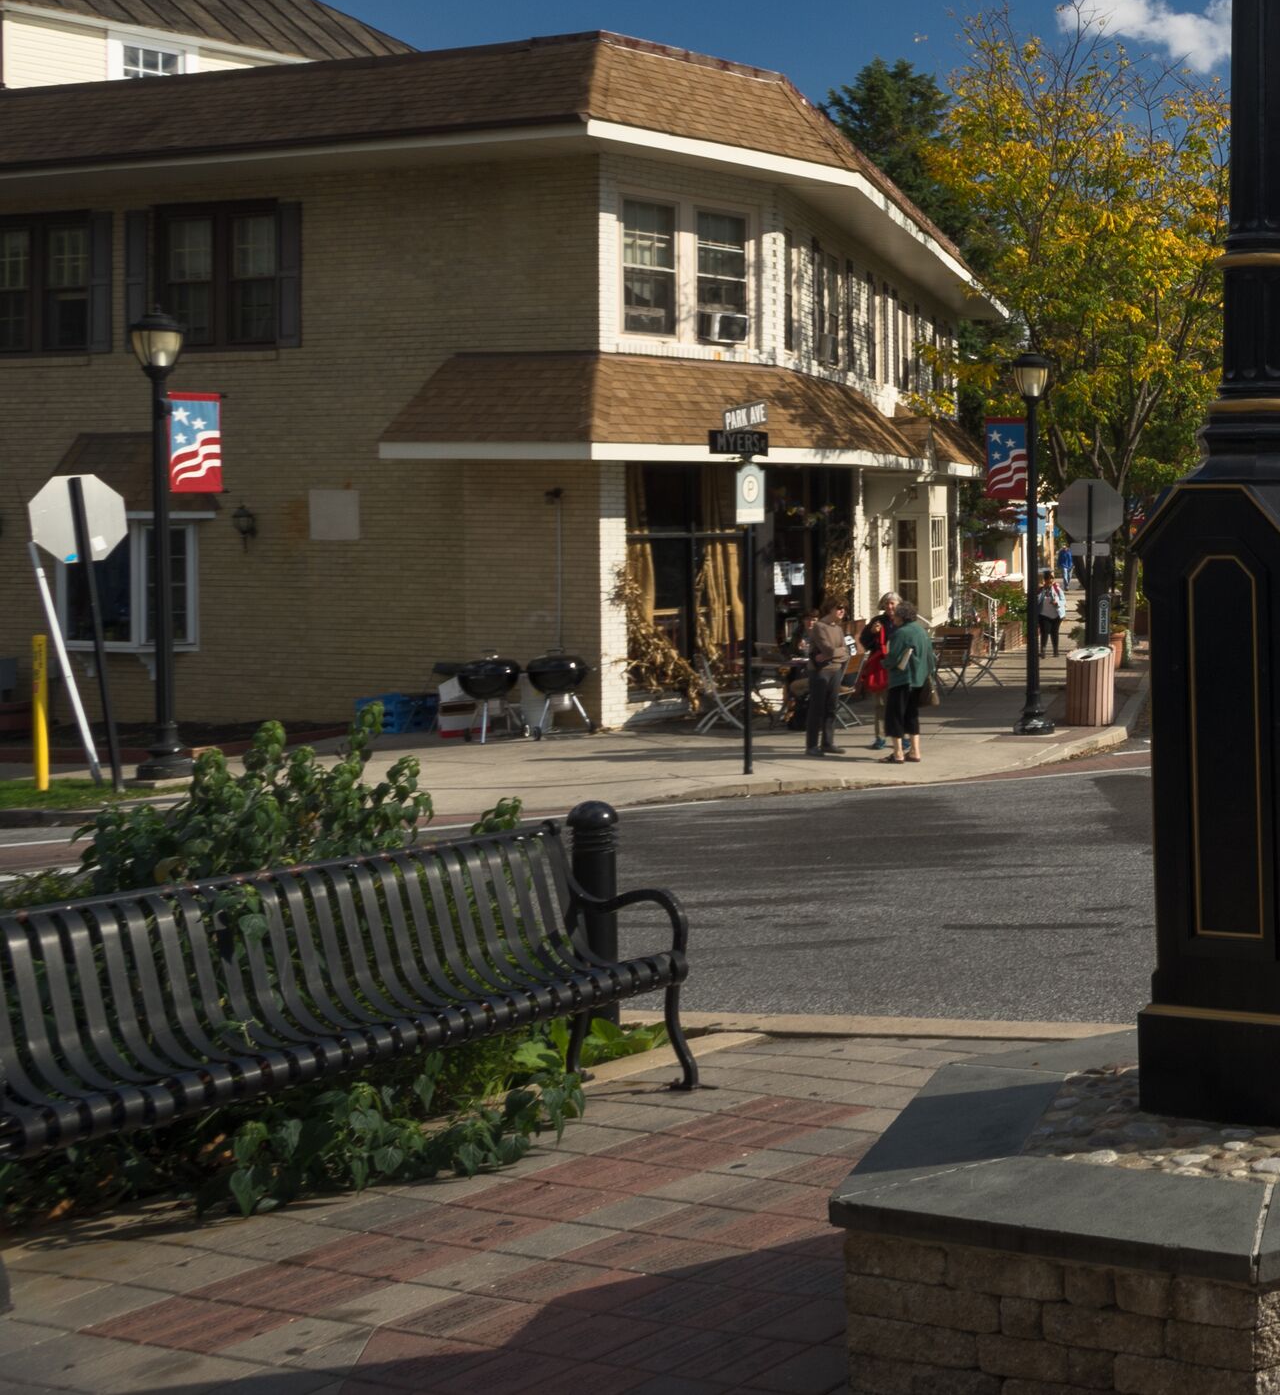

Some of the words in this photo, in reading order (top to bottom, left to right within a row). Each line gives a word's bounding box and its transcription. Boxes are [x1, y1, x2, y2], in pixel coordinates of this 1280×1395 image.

[725, 408, 748, 431] PARK
[750, 403, 767, 425] AVE
[716, 433, 760, 452] MYERS
